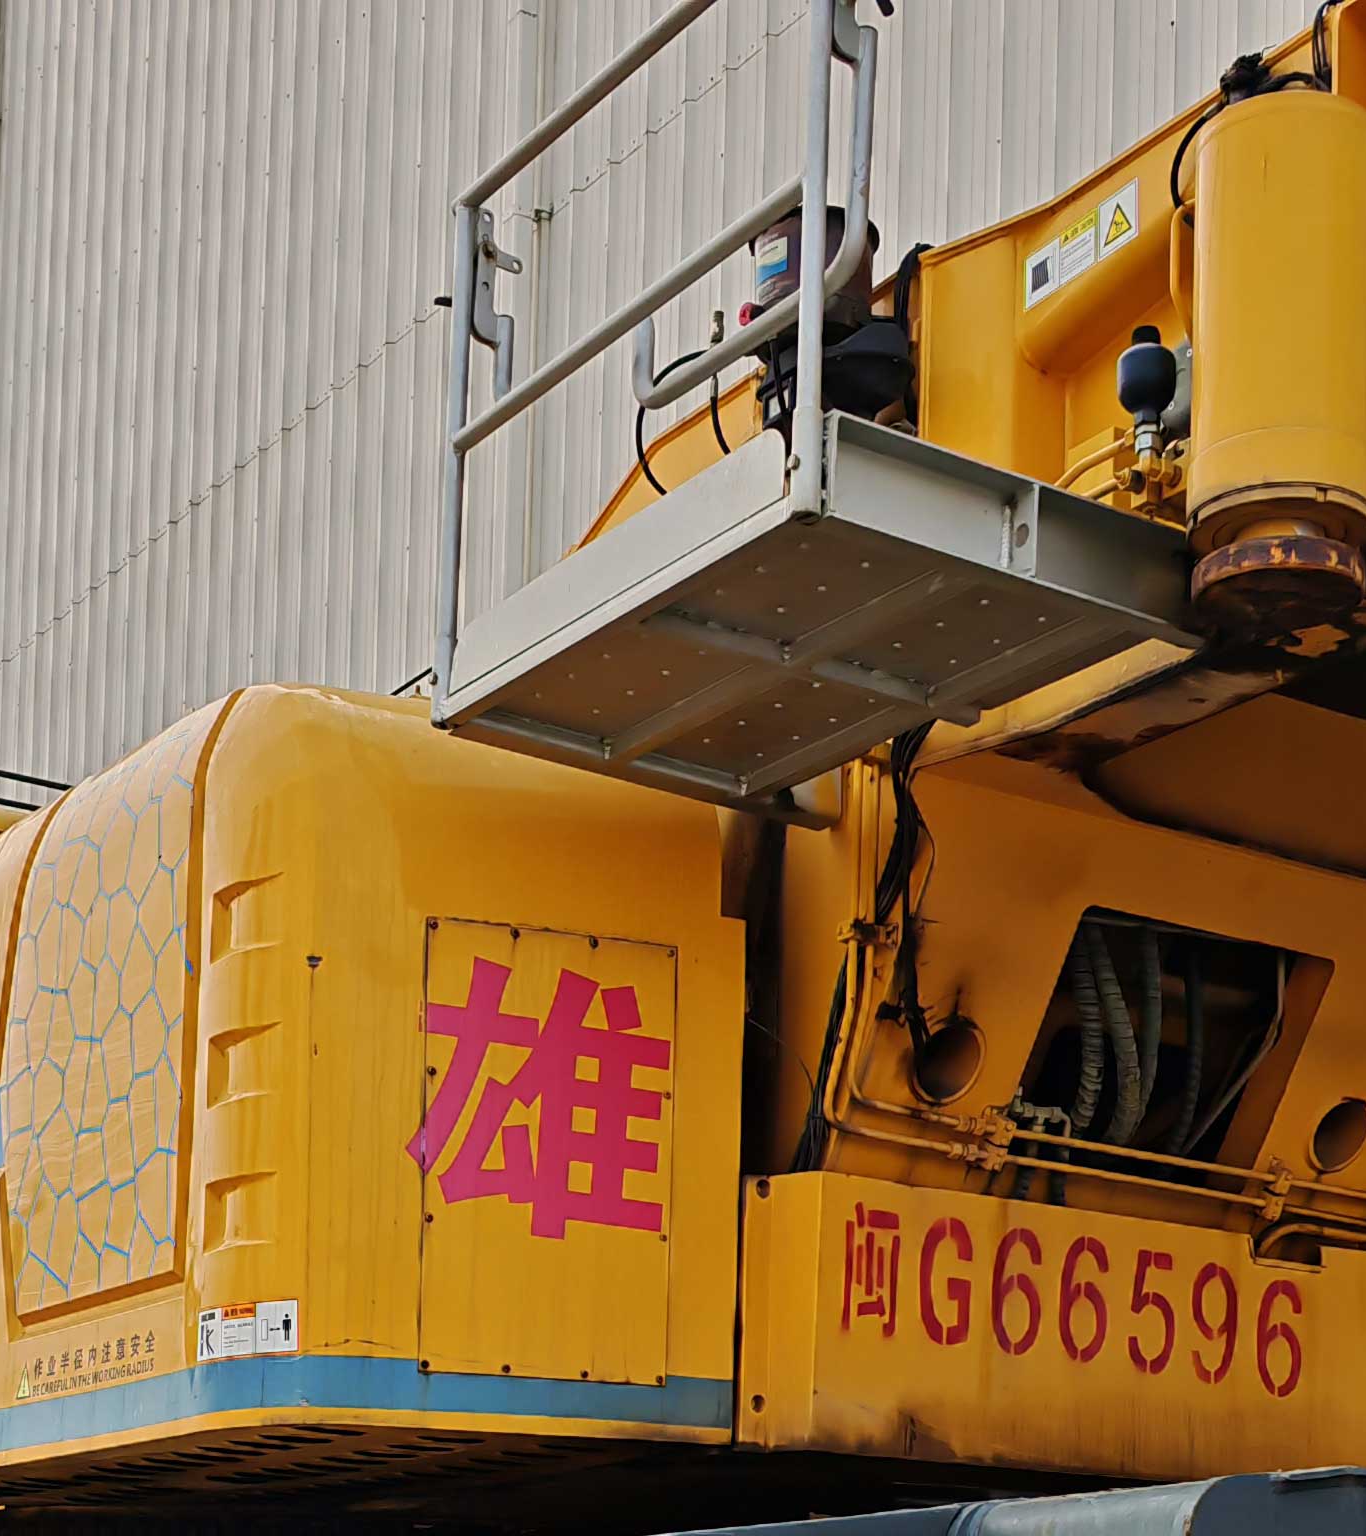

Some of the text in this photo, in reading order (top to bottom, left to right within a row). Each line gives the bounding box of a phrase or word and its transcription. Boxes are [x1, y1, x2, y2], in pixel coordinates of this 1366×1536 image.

[405, 955, 672, 1240] 雄
[33, 1329, 156, 1381] 作业半径内注意安全
[40, 1379, 68, 1396] CAREFUL
[77, 1373, 91, 1389] THE
[91, 1366, 126, 1385] WORKING
[126, 1357, 155, 1376] RADIUS
